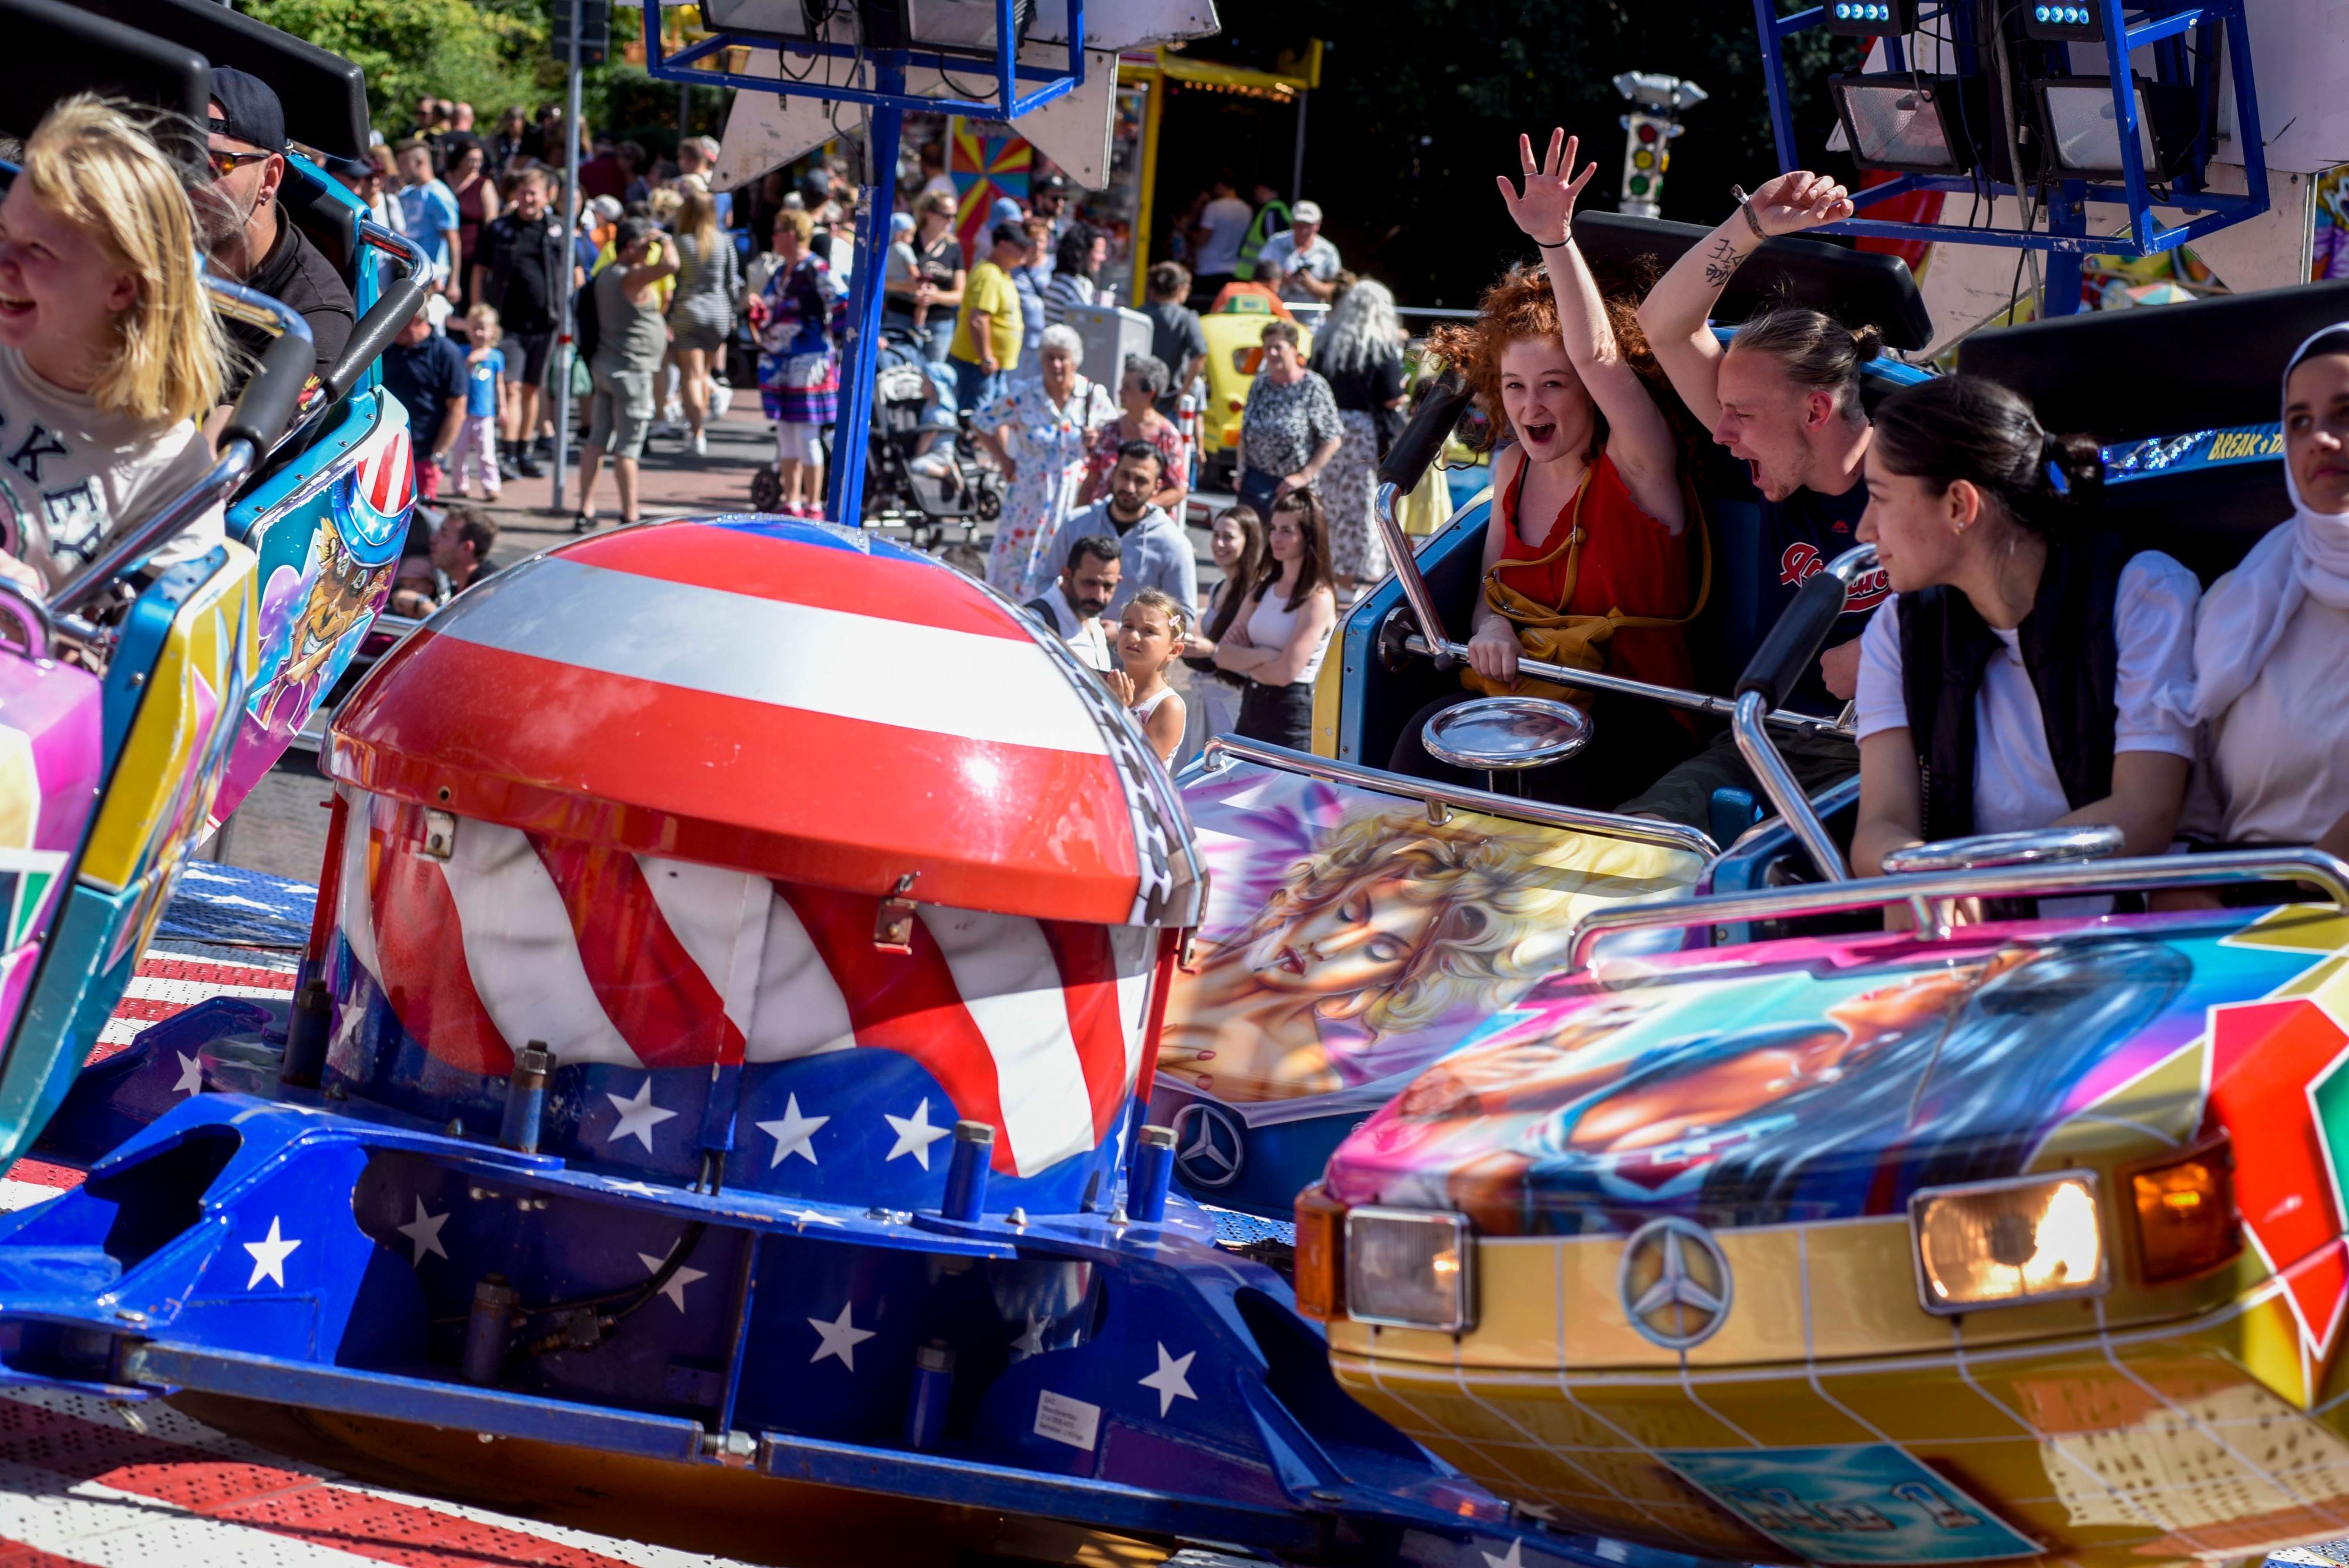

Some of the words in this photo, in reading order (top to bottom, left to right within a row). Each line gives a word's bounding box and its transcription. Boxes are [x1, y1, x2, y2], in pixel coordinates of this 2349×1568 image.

[1707, 238, 1749, 267] DIE
[2207, 433, 2262, 460] BREAK
[0, 413, 100, 564] KEY
[1890, 1482, 1983, 1527] 1
